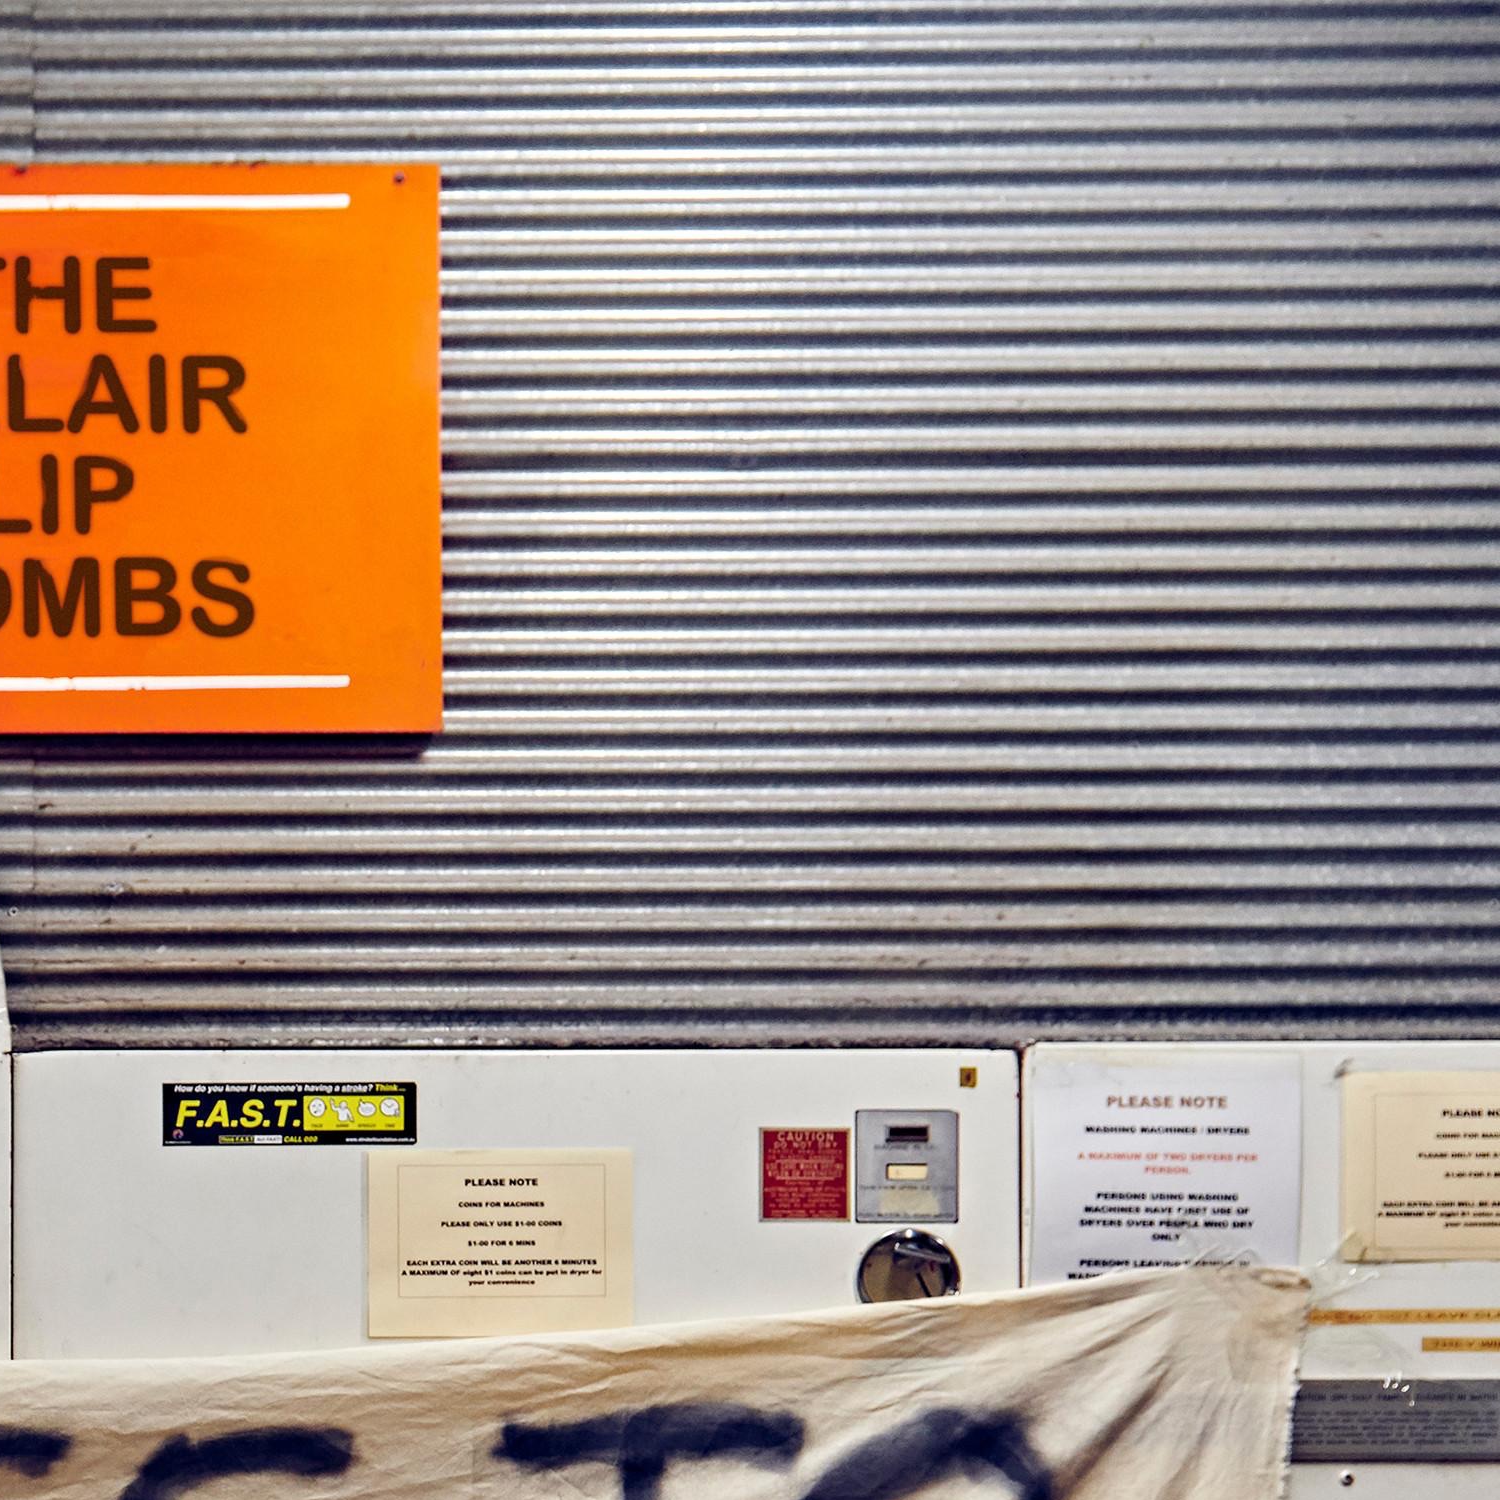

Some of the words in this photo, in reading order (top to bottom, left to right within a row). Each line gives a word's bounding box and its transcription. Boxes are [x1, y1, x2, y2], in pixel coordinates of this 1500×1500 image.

[207, 1086, 224, 1094] you
[249, 1084, 256, 1092] if
[304, 1084, 333, 1093] having
[341, 1084, 374, 1092] stroke?
[1107, 1096, 1173, 1108] PLEASE
[1180, 1096, 1227, 1108] NOTE
[176, 1099, 301, 1128] F.A.S.T.
[777, 1132, 834, 1141] CAUTION
[509, 1178, 538, 1186] NOTE
